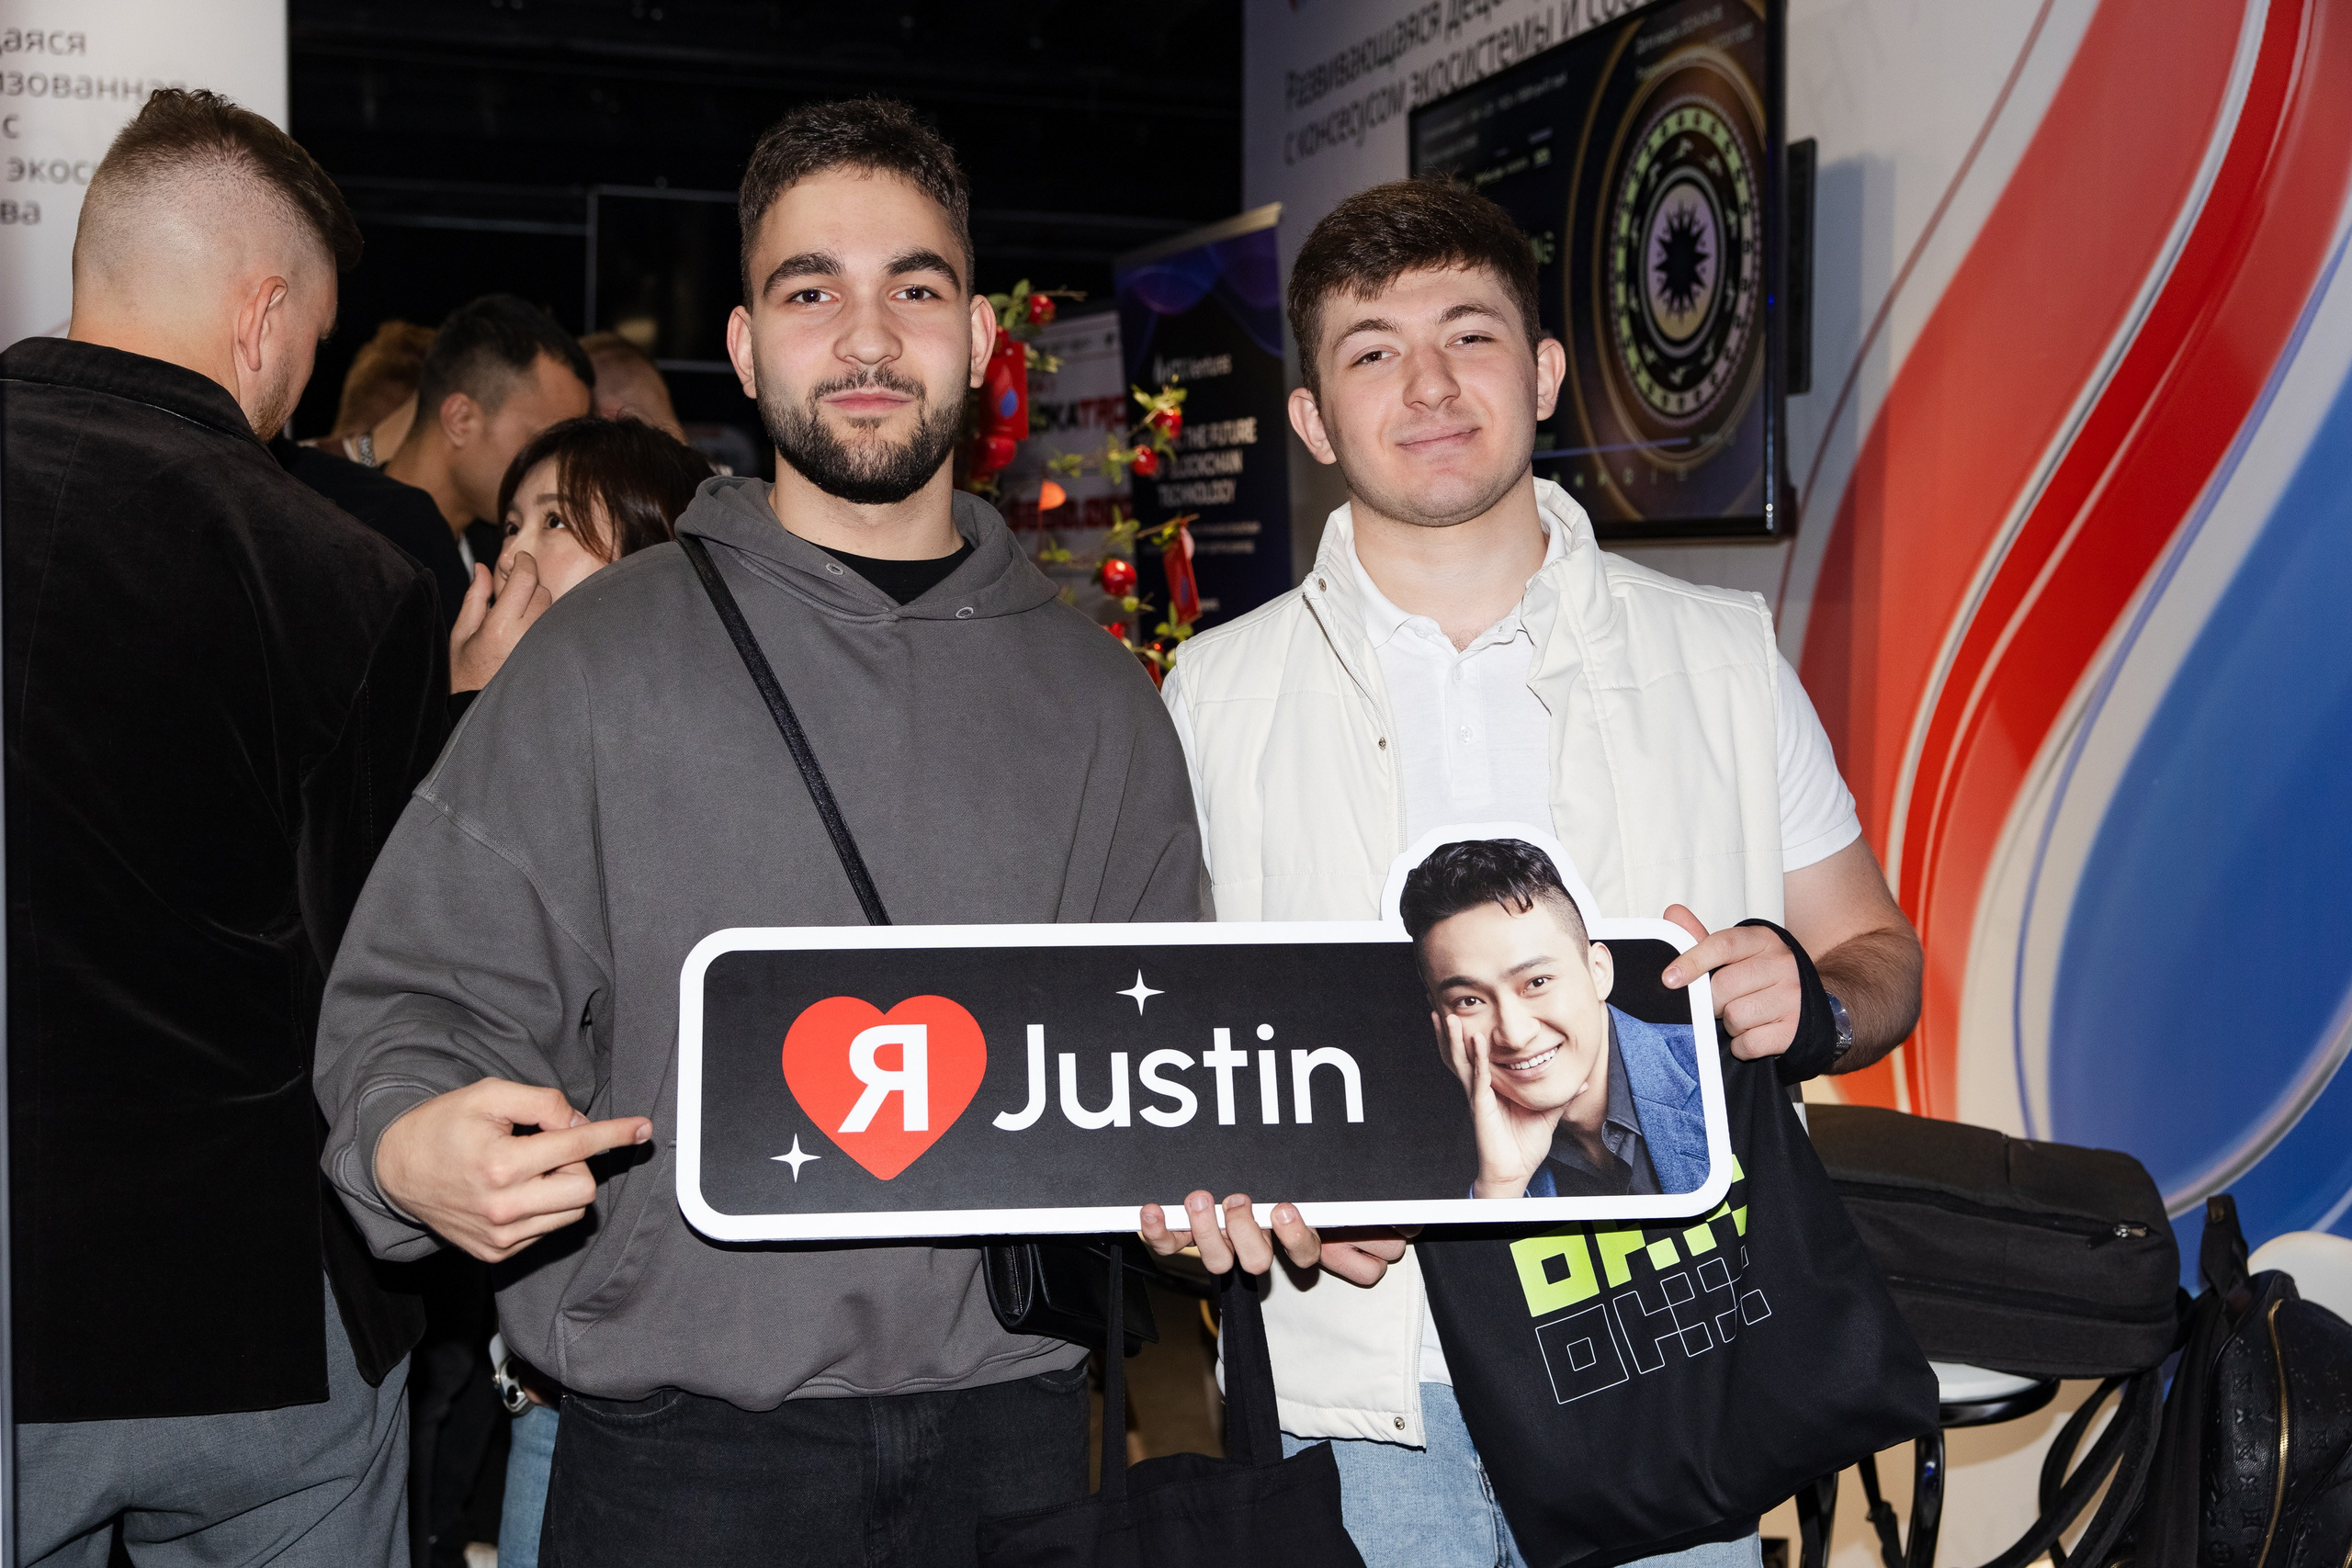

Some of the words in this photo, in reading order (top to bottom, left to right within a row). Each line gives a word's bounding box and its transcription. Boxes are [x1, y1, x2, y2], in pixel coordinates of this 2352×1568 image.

[0, 28, 86, 55] аяся
[3, 114, 20, 139] с
[7, 156, 96, 185] экос
[837, 1023, 929, 1133] Я
[991, 1023, 1364, 1132] Justin
